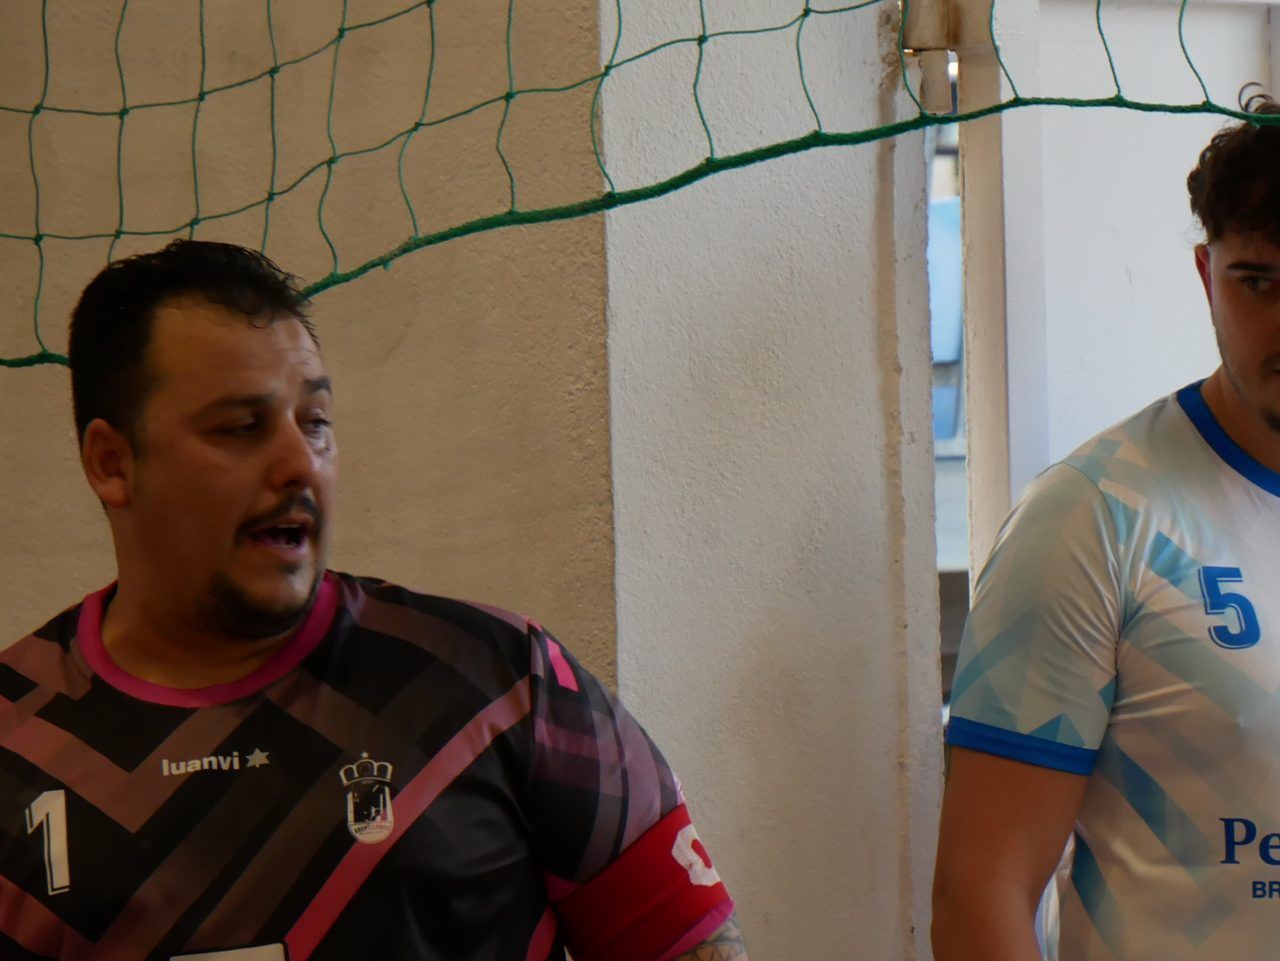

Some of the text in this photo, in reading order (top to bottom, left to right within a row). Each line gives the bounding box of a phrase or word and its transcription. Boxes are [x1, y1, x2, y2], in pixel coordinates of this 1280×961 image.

[1198, 565, 1261, 650] 5
[161, 751, 240, 776] luanvi
[25, 789, 70, 896] 1
